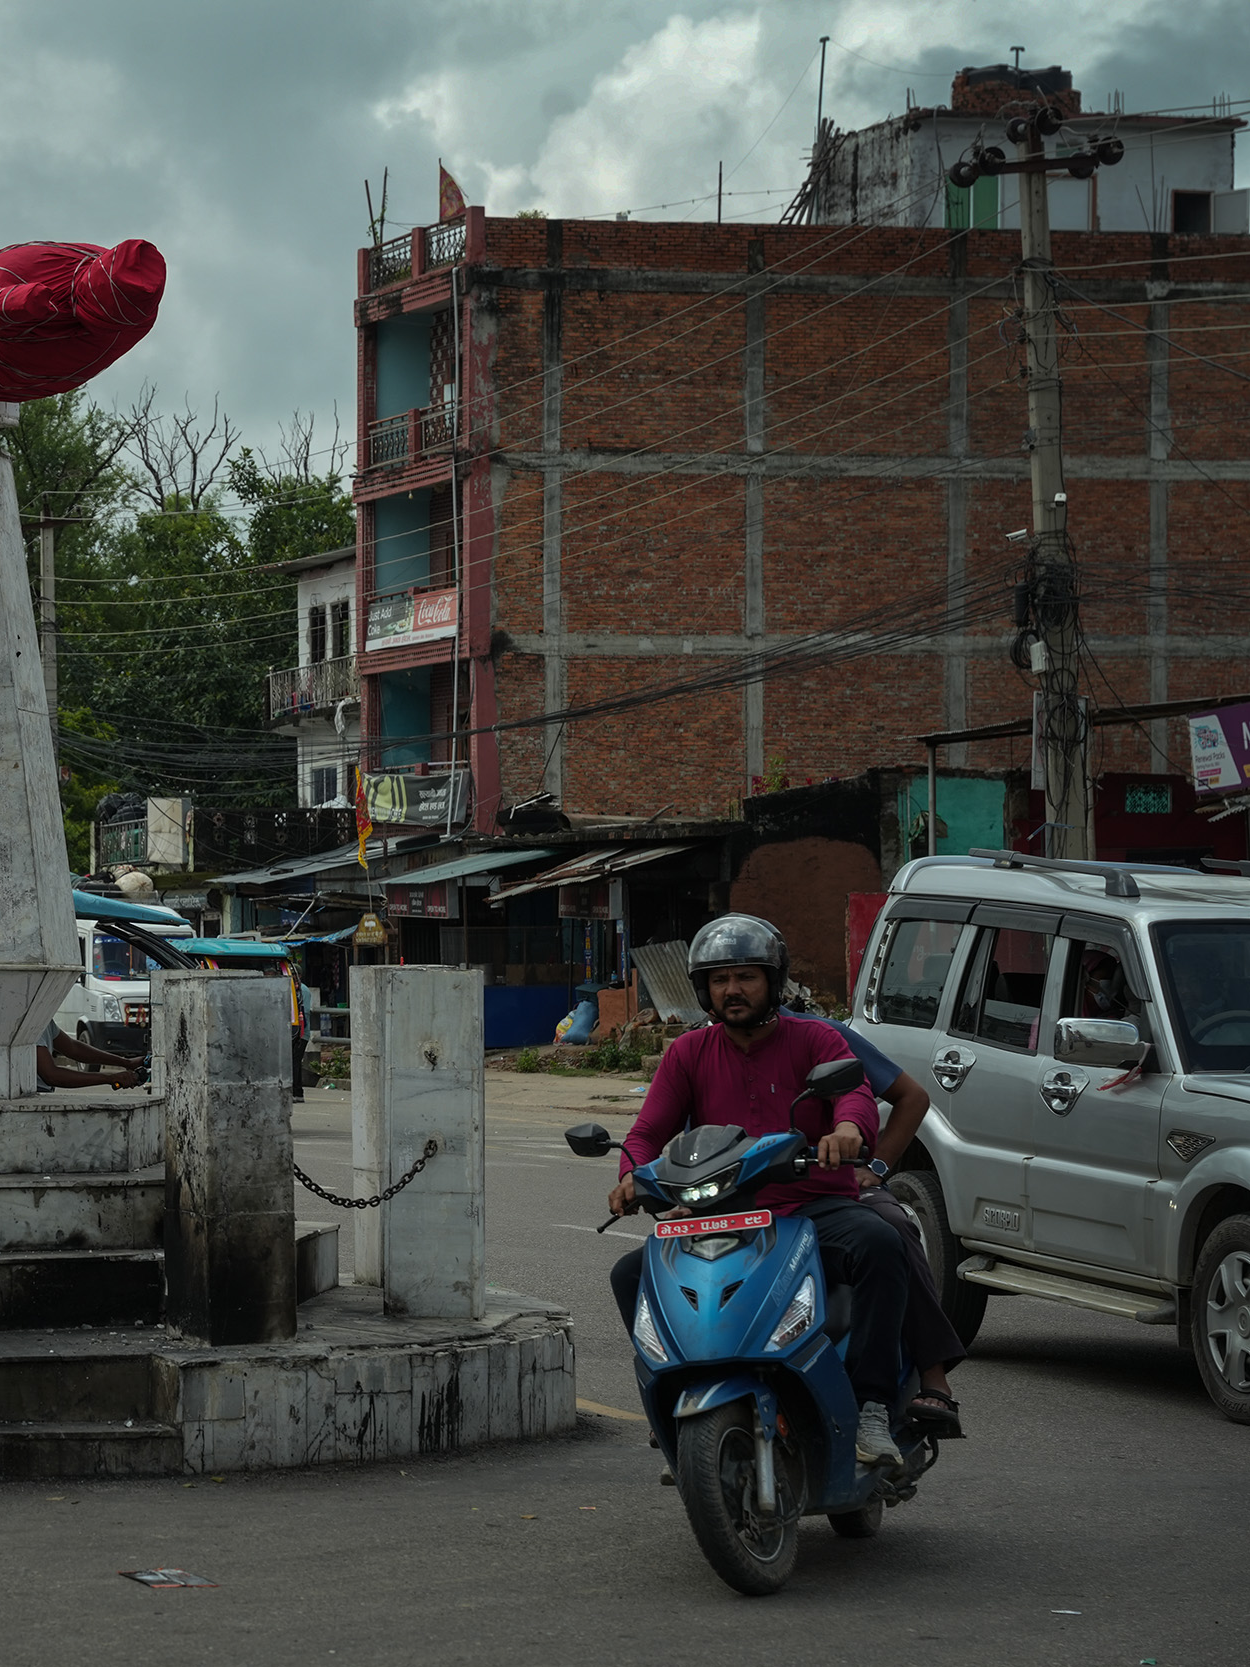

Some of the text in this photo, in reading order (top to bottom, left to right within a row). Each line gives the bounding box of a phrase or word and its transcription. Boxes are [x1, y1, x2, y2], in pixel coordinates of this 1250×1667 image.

[368, 606, 392, 622] Just Add
[367, 624, 381, 637] Coke
